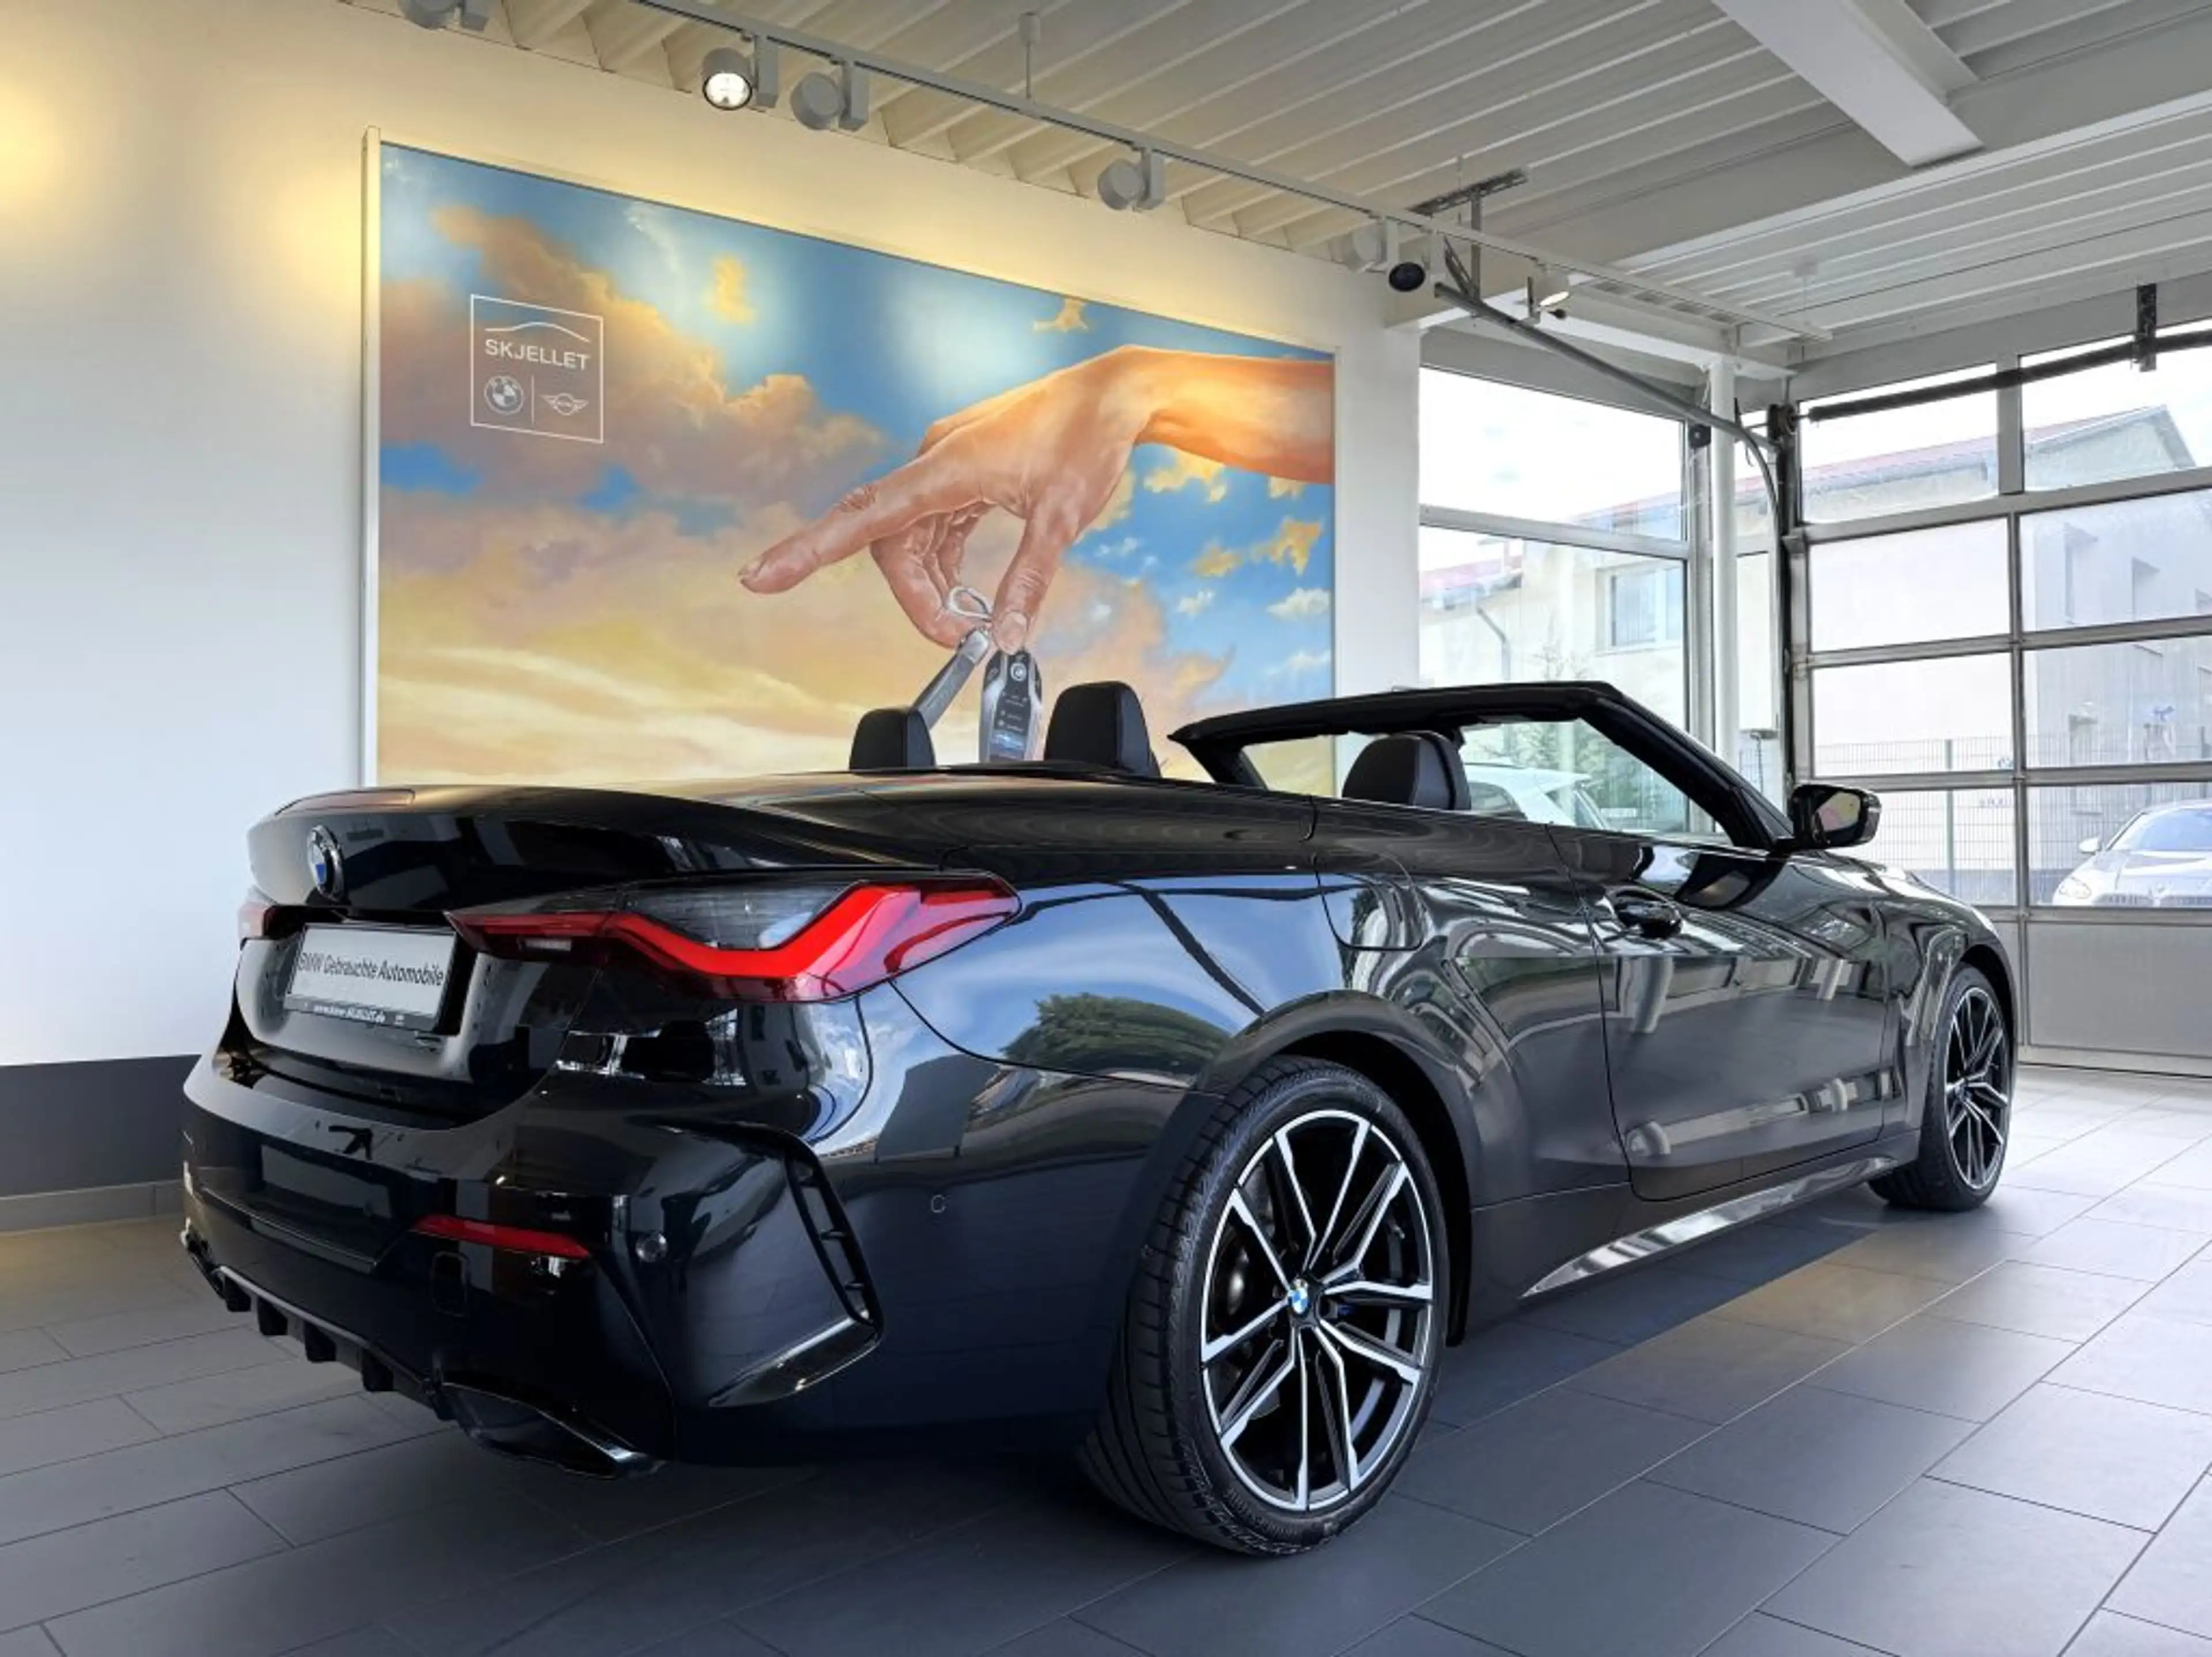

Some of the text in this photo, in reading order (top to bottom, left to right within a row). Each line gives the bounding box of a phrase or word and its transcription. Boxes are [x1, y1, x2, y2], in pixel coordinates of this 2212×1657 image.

[484, 339, 589, 370] SKJELLET
[324, 954, 378, 979] Gebrauchte
[378, 959, 444, 986] Automobile
